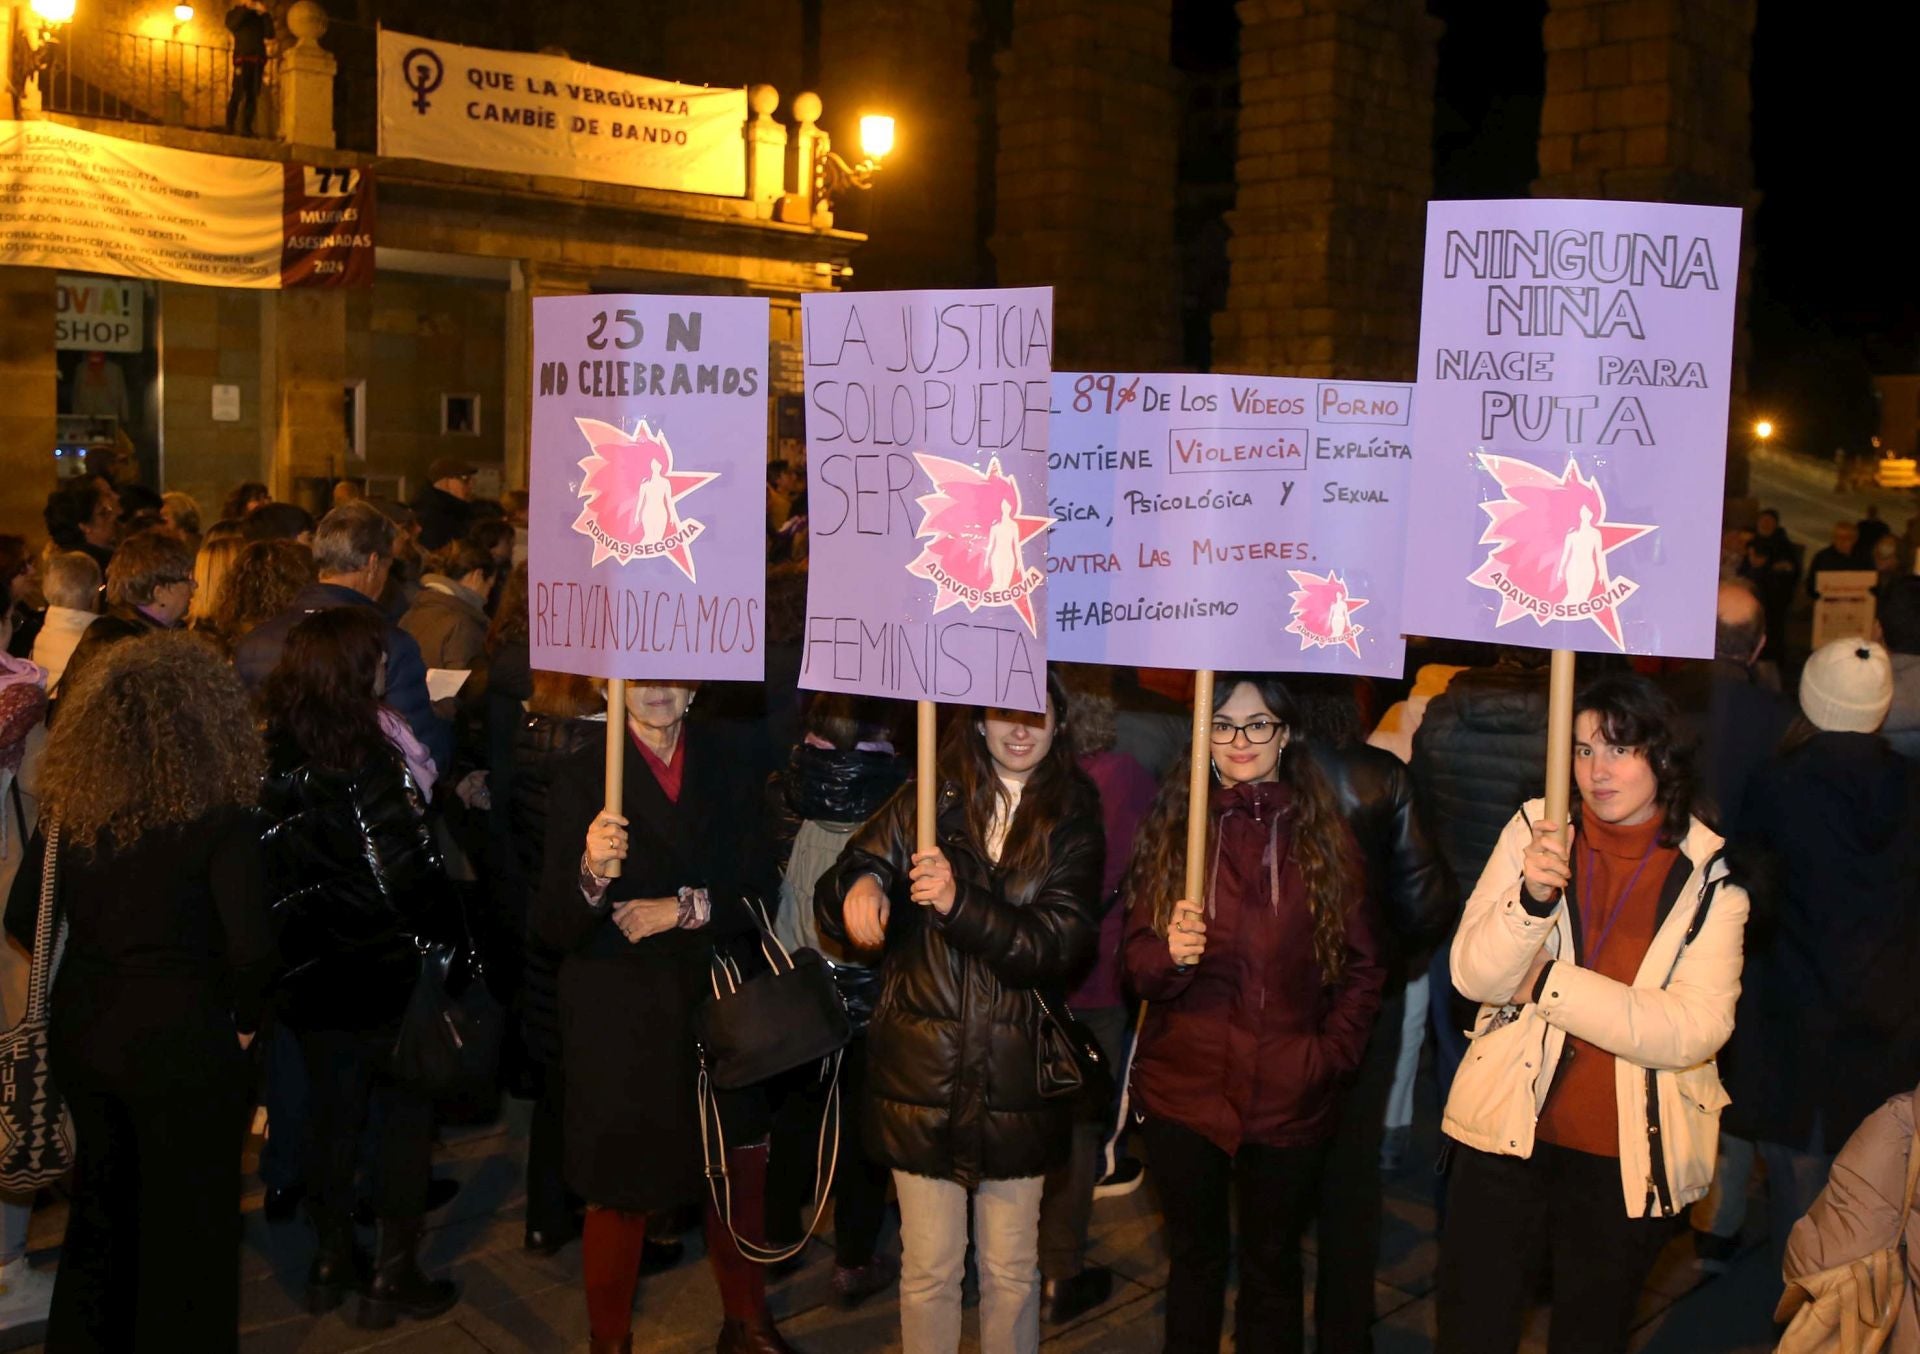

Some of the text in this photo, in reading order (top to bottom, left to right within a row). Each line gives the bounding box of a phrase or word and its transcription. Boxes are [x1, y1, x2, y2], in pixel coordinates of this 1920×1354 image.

[466, 68, 690, 116] QUE LA VERGÜENZA
[466, 102, 688, 146] CAMBIE DE BANDO
[315, 167, 351, 194] 77
[286, 234, 372, 250] ASESINADAS
[1444, 229, 1719, 290] NINGUNA
[56, 320, 130, 343] SHOP
[586, 309, 702, 352] 25 N
[1487, 285, 1646, 340] NIÑA
[806, 303, 1052, 374] LA JUSTICIA
[540, 359, 759, 397] NO CELEBRAMOS
[1436, 349, 1709, 389] NACE PARA
[1072, 374, 1140, 414] 89%
[812, 379, 1050, 453] SOLO PUEDE
[1481, 390, 1656, 446] PUTA
[815, 454, 917, 537] SER
[586, 519, 700, 556] ADAVAS SEGOVIA
[926, 562, 1041, 604] ADAVAS SEGOVIA
[1490, 571, 1632, 617] ADAVAS SEGOVIA
[1296, 624, 1326, 644] ADAVAS
[804, 616, 1041, 710] FEMINISTA
